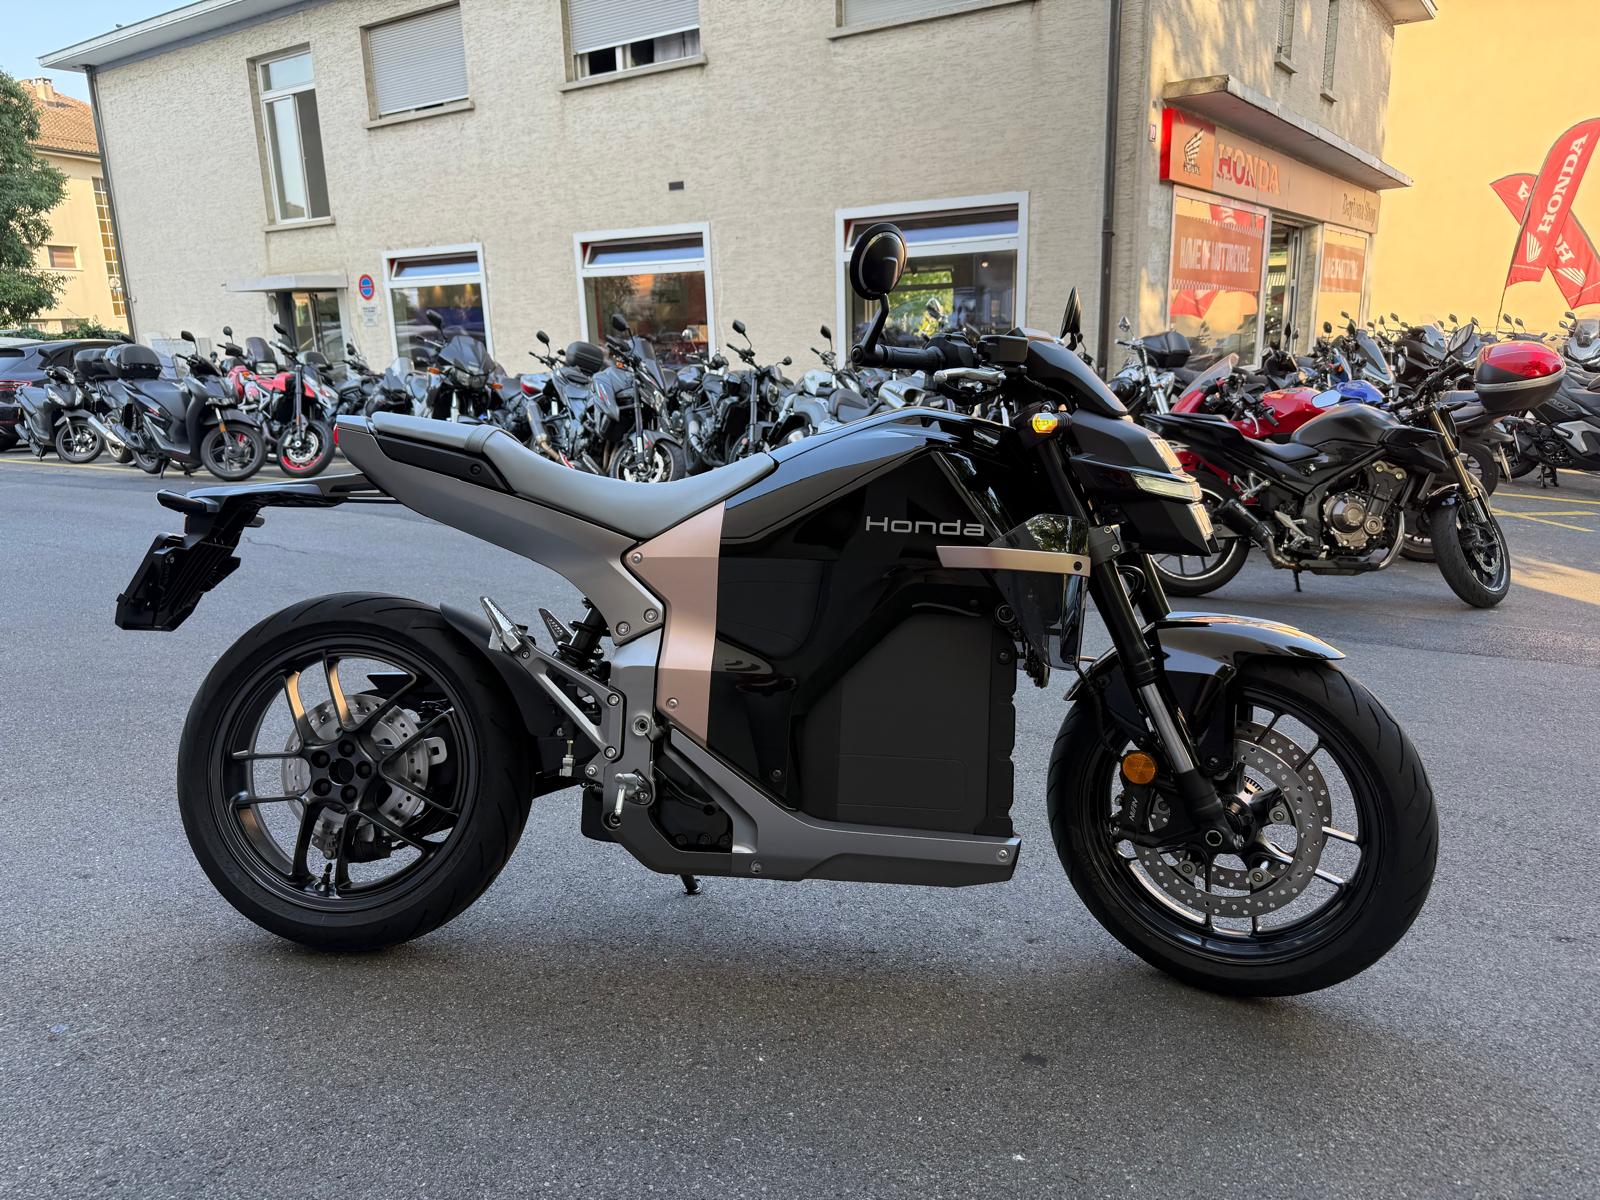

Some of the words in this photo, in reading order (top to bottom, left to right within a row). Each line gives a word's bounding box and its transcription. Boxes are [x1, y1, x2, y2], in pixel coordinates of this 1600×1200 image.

[1216, 143, 1281, 195] HONDA
[1537, 133, 1589, 233] HONDA
[865, 515, 985, 537] Honda
